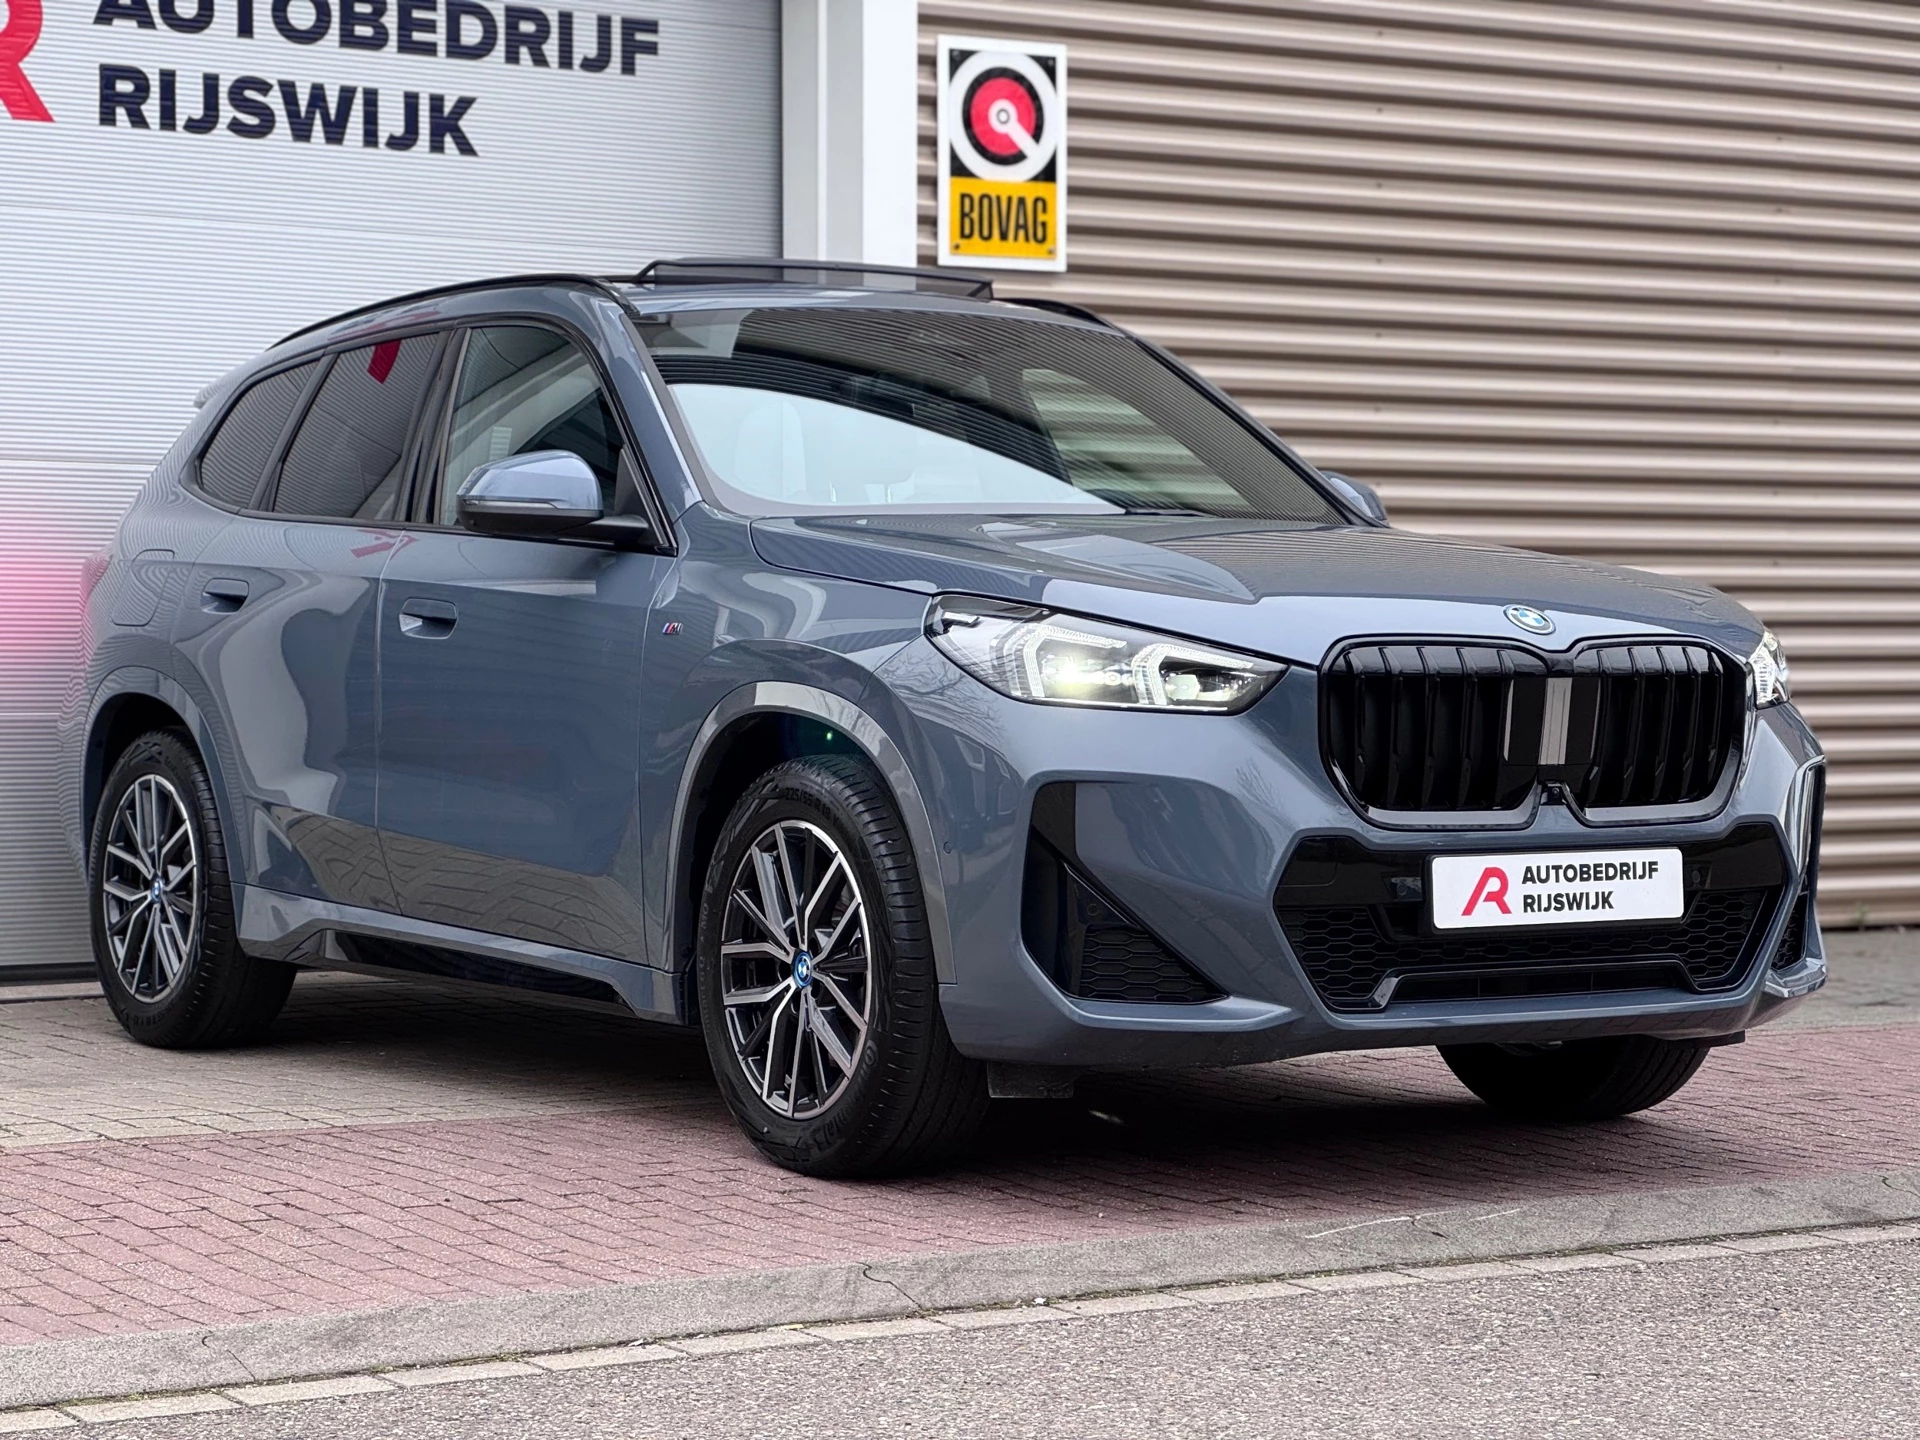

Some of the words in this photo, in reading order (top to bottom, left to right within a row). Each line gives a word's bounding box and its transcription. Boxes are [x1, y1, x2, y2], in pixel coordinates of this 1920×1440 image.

[99, 64, 479, 157] RIJSWIJK
[959, 193, 1047, 244] BOVAG
[1521, 860, 1659, 885] AUTOBEDRIJF
[1523, 890, 1614, 913] RIJSWIJK
